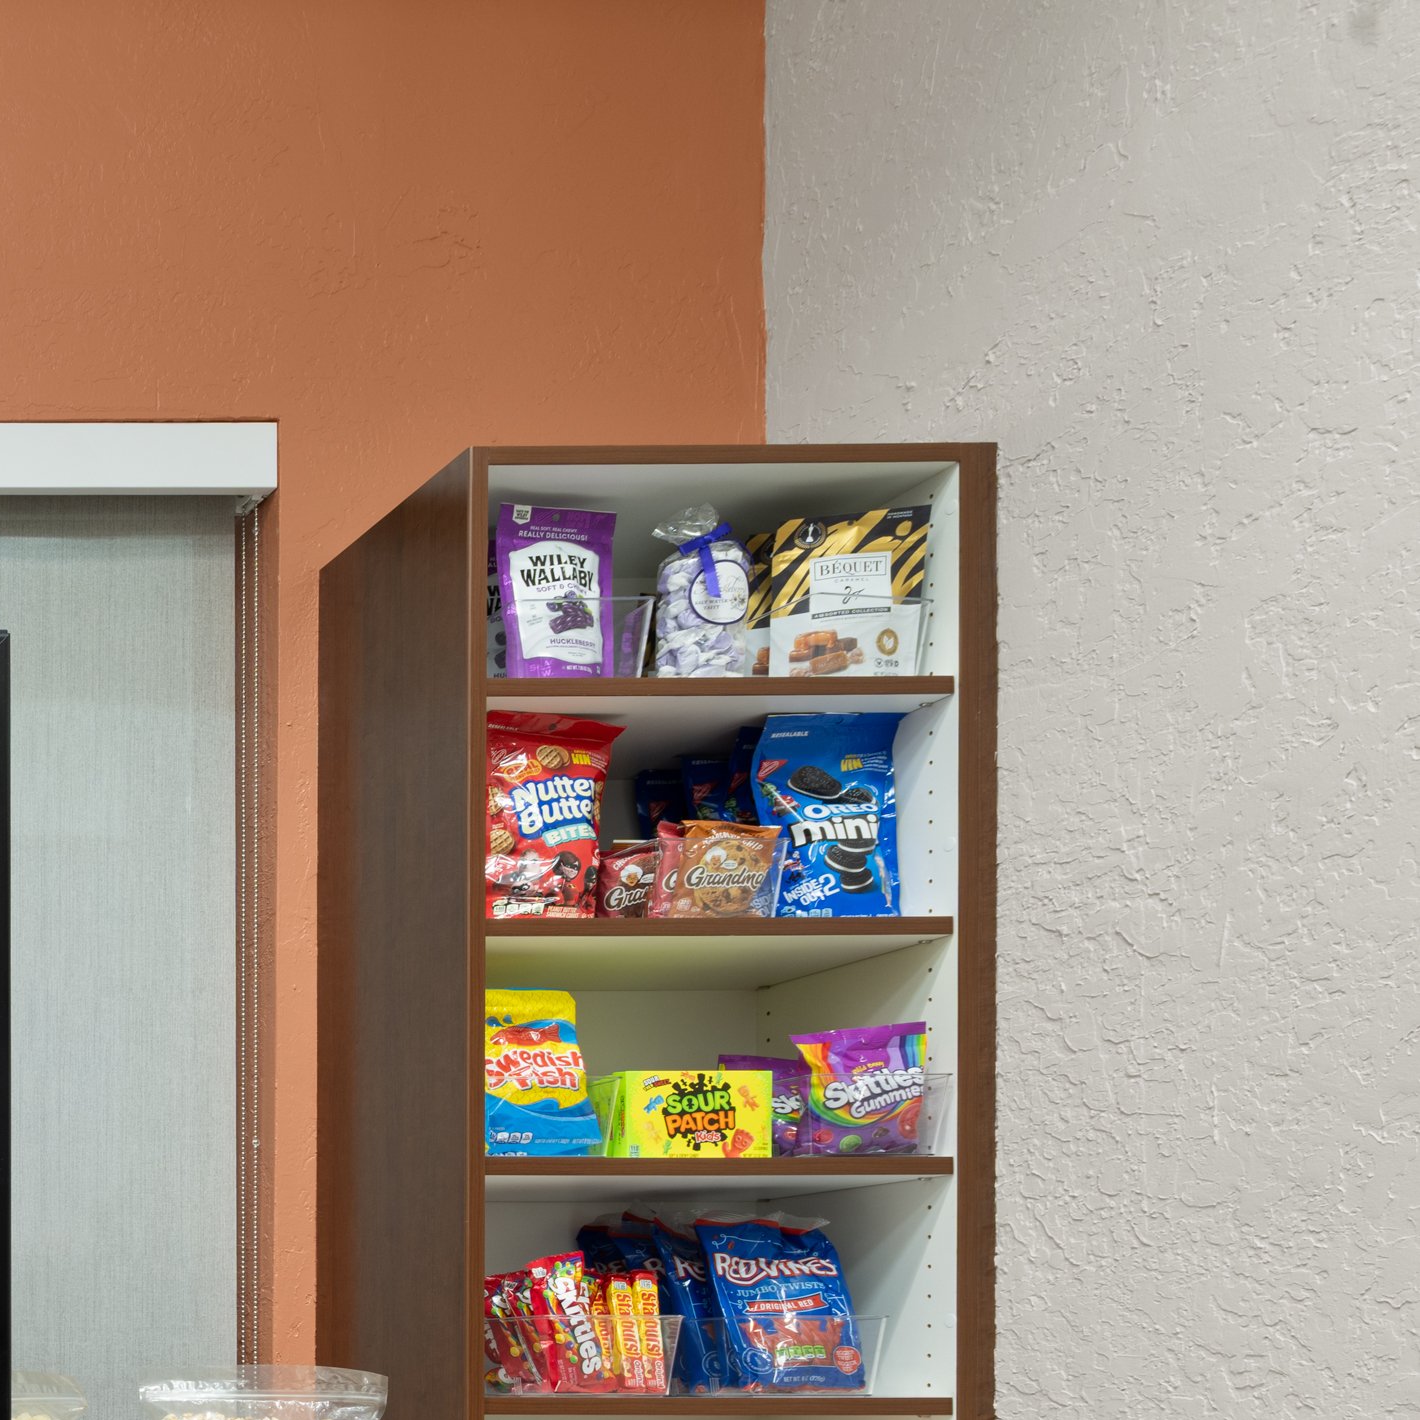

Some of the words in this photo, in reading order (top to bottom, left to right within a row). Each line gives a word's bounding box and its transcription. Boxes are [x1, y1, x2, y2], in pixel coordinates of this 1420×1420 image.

[518, 531, 544, 539] REALLY
[546, 533, 588, 541] DELICIOUS!
[527, 554, 587, 568] WILEY
[819, 560, 885, 576] BÉQUET
[521, 568, 594, 589] WALLABY
[550, 638, 596, 648] HUCKLEBERRY
[803, 803, 878, 819] OREO
[794, 817, 878, 844] mini
[824, 1069, 926, 1108] Skittles
[666, 1091, 730, 1112] SOUR
[665, 1111, 735, 1133] PATCH
[696, 1130, 721, 1143] Kids
